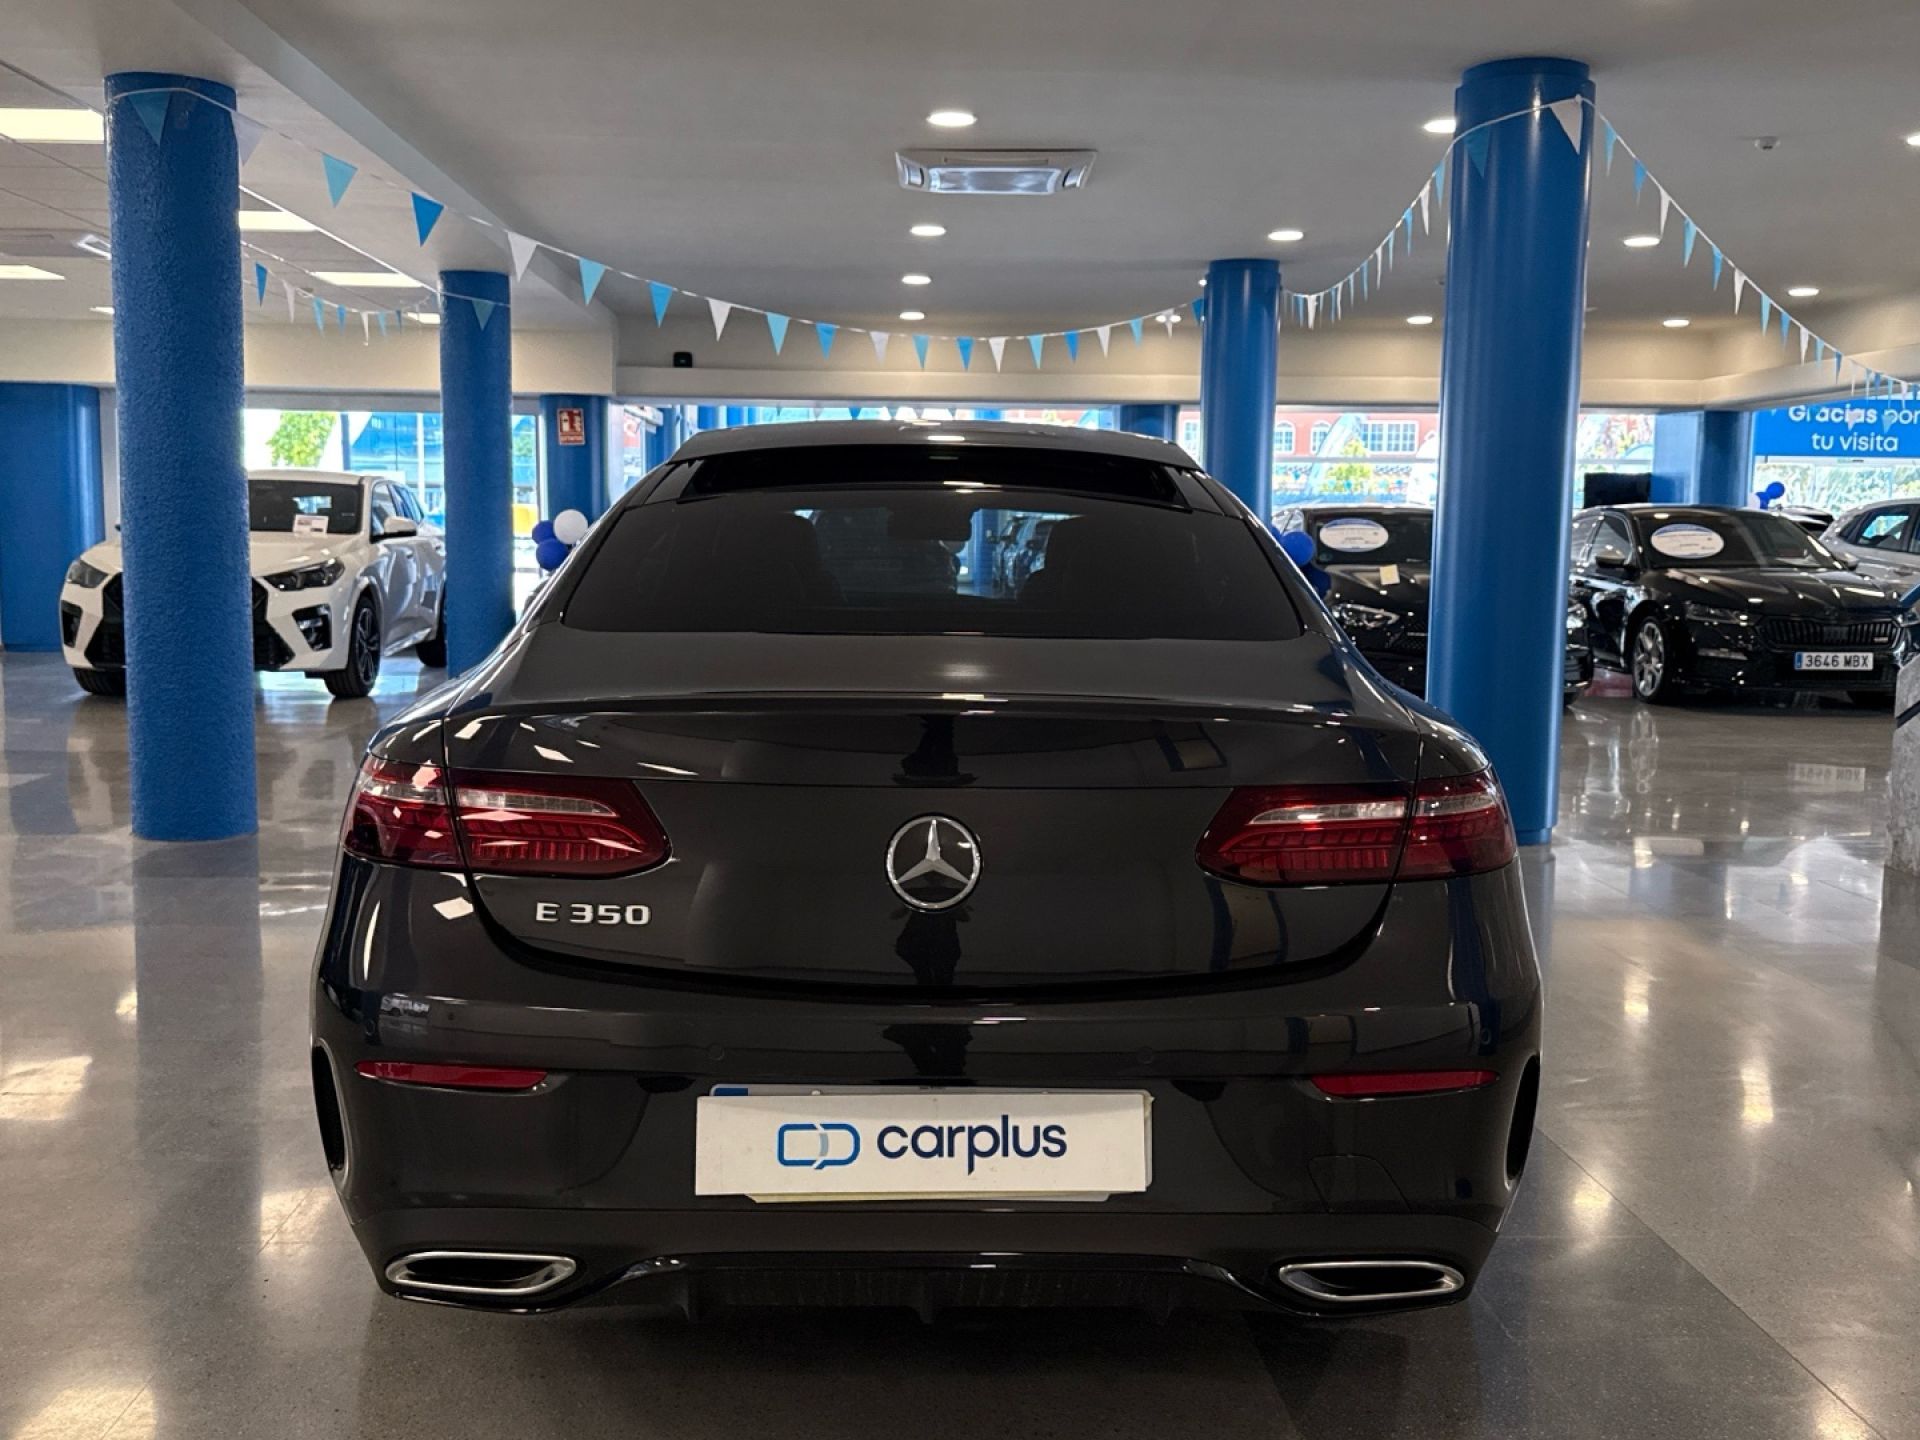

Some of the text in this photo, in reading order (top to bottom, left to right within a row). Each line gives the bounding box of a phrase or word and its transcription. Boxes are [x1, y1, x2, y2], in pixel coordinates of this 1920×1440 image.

[1812, 432, 1898, 452] tu visita
[1806, 655, 1869, 667] 3646 MBX
[535, 902, 650, 925] E 350
[876, 1114, 1067, 1176] carplus
